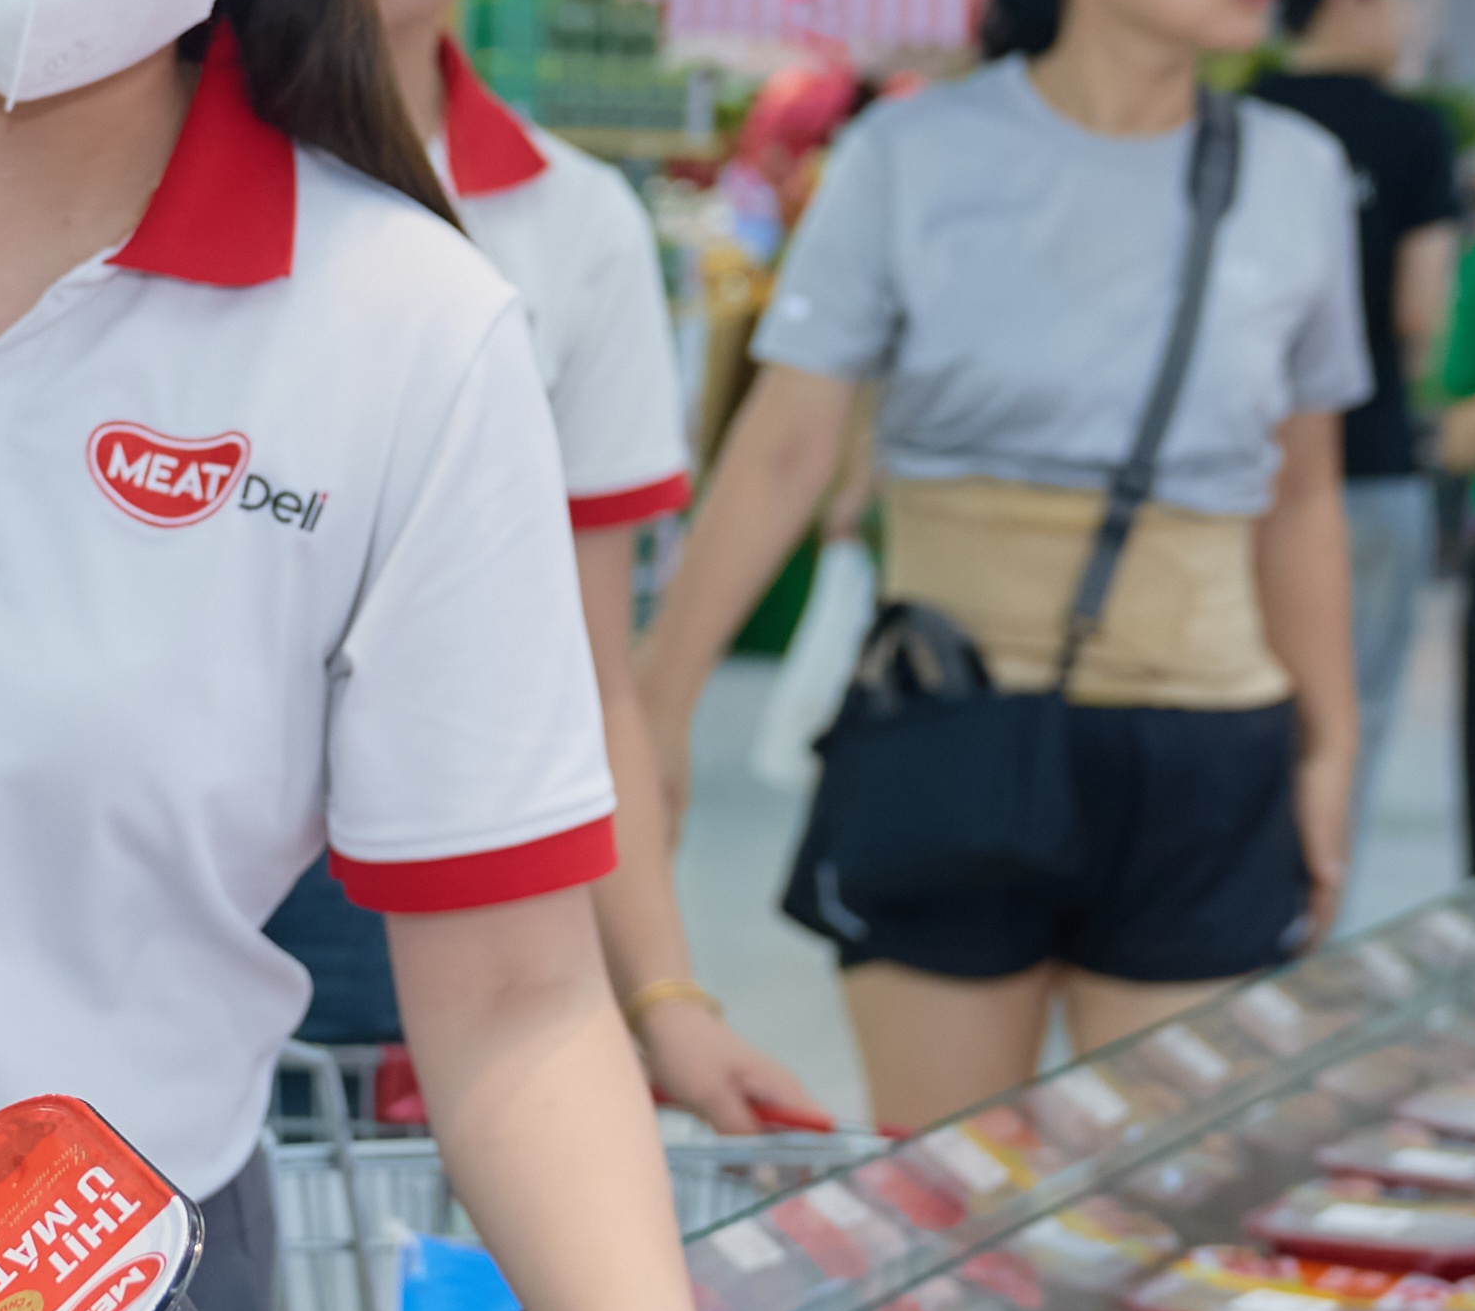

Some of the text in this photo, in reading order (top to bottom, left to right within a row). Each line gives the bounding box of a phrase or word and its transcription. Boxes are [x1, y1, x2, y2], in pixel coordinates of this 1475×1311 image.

[106, 441, 330, 534] MEAT Deli
[75, 1164, 114, 1203] Ủ
[47, 1190, 141, 1284] THỊT
